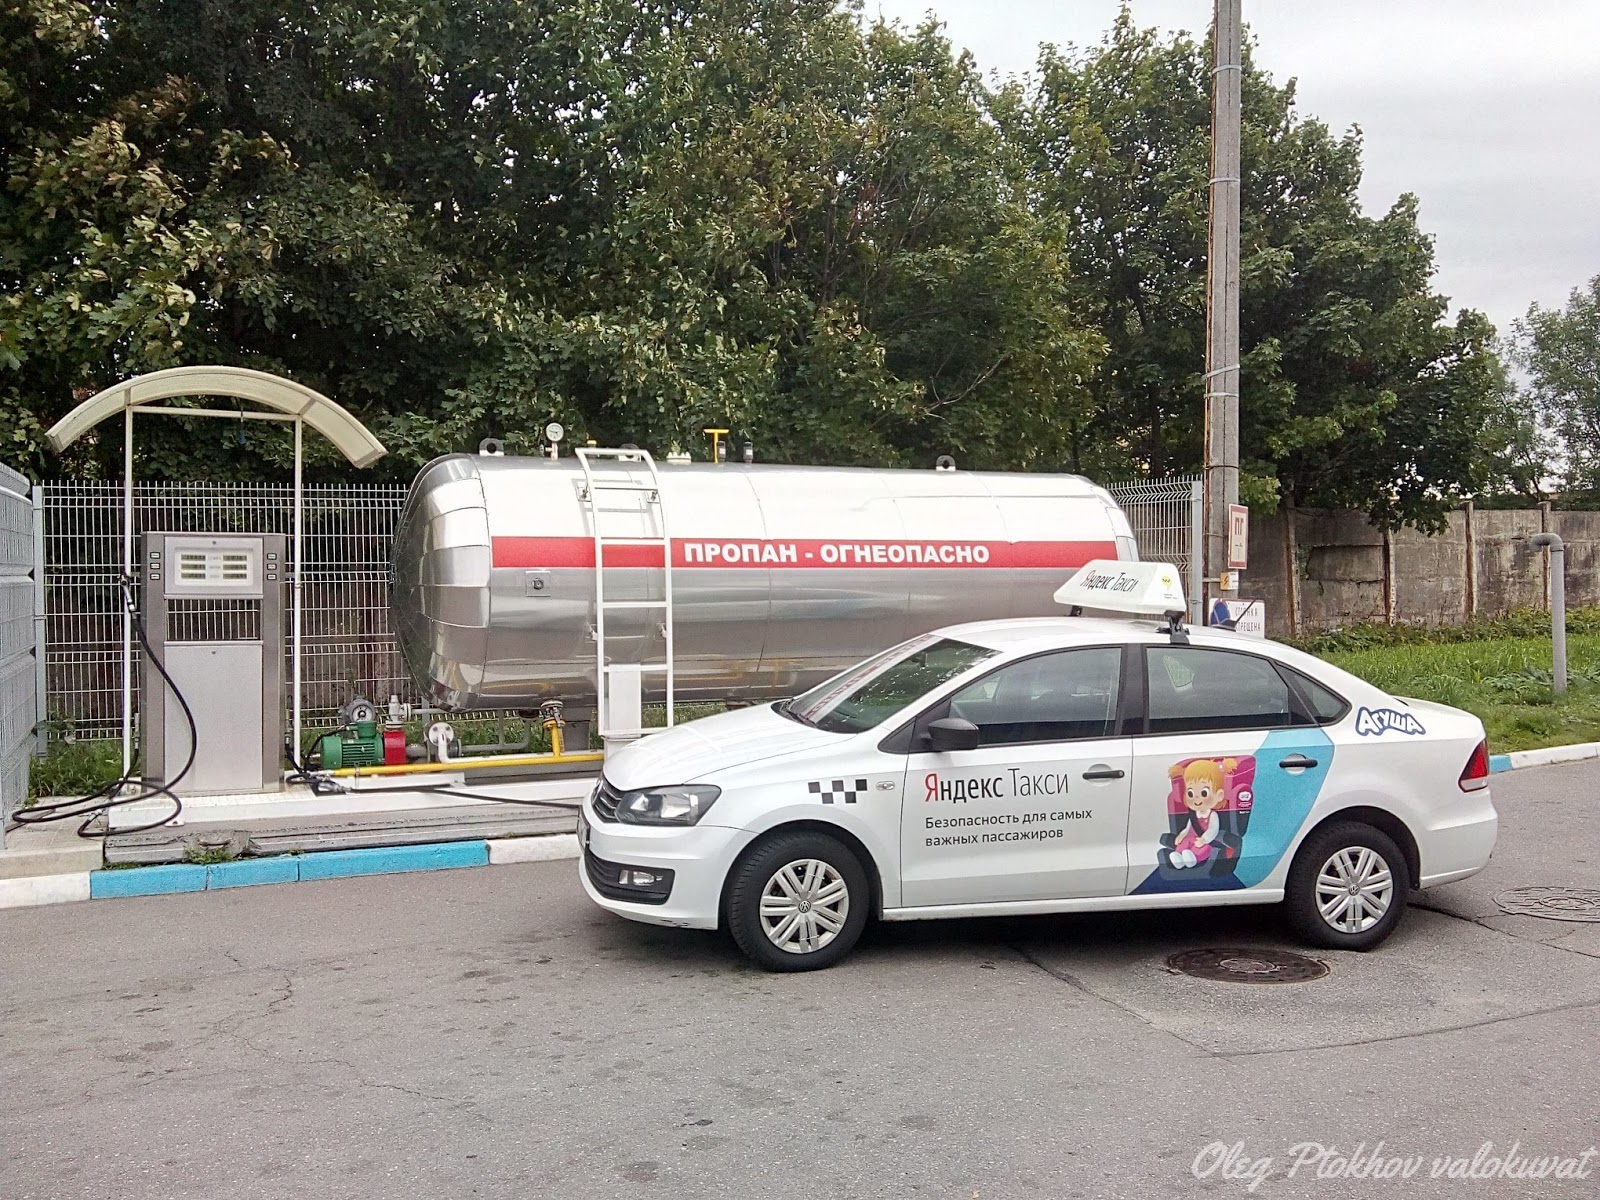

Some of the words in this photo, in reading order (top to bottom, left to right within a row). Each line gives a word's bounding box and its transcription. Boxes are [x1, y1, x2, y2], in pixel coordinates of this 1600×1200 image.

[683, 543, 797, 563] ПРОПАН
[820, 544, 990, 564] ОГНЕОПАСНО
[1080, 569, 1115, 591] Яндекс
[1110, 572, 1140, 593] Такси
[924, 773, 1004, 804] Яндекс
[1007, 767, 1070, 797] Такси
[925, 815, 1020, 829] Безопасность
[1022, 812, 1047, 825] для
[1050, 809, 1093, 821] самых
[925, 833, 979, 847] важных
[982, 828, 1064, 844] пассажиров
